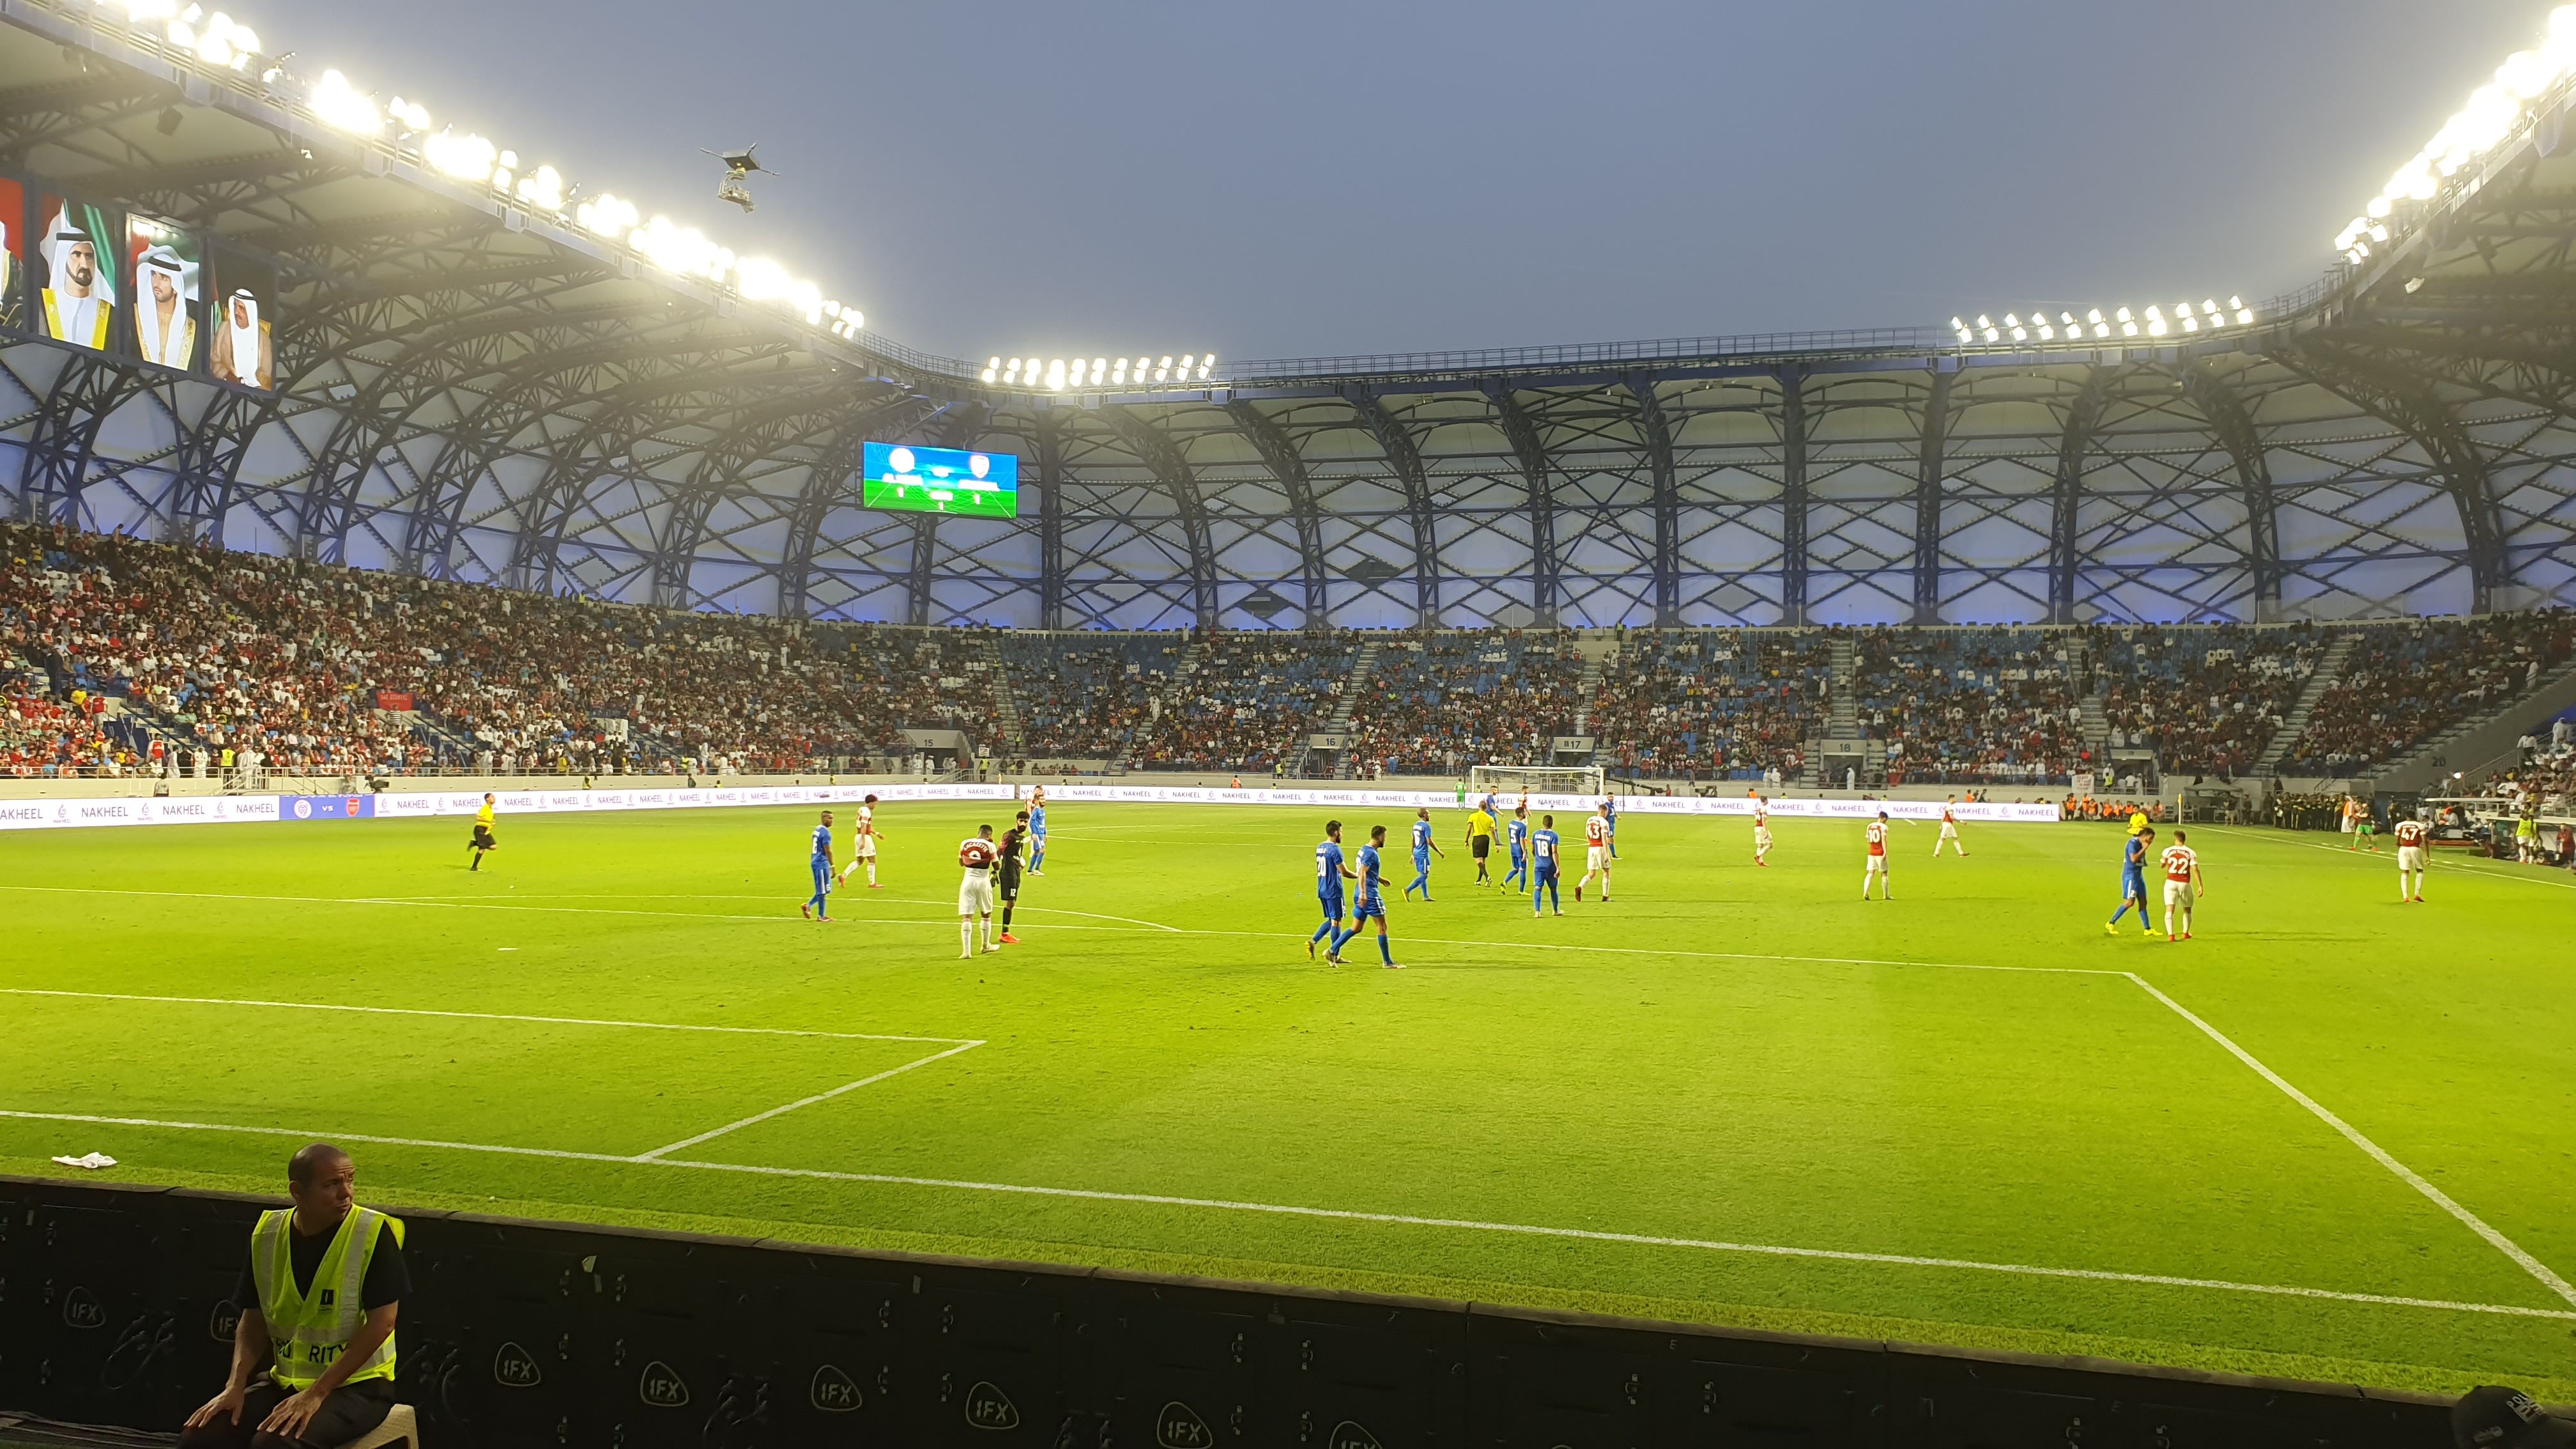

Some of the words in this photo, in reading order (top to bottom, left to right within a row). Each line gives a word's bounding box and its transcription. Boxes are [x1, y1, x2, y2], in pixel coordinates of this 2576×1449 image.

[924, 739, 933, 747] 15
[1326, 738, 1335, 746] 16
[1570, 740, 1581, 749] 17
[1840, 743, 1851, 752] 18
[2432, 756, 2446, 767] 20
[397, 800, 429, 809] NAKHEEL
[452, 799, 482, 808] NAKHEEL
[504, 797, 532, 806] NAKHEEL
[553, 797, 579, 805] NAKHEEL
[597, 796, 622, 804] NAKHEEL
[0, 808, 43, 820] AKHEEL
[81, 806, 128, 818] NAKHEEL
[163, 805, 205, 816] NAKHEEL
[236, 803, 275, 814] NAKHEEL
[1510, 829, 1517, 843] 5
[1868, 829, 1880, 843] 10
[2401, 828, 2419, 840] 47
[1536, 839, 1549, 857] 18
[2168, 857, 2188, 874] 22
[1010, 888, 1016, 897] 12
[72, 1303, 97, 1321] IFX
[503, 1360, 532, 1379] IFX
[650, 1378, 680, 1400] IFX
[821, 1383, 852, 1403] IFX
[976, 1400, 1009, 1422] IFX
[1168, 1420, 1202, 1442] IFX
